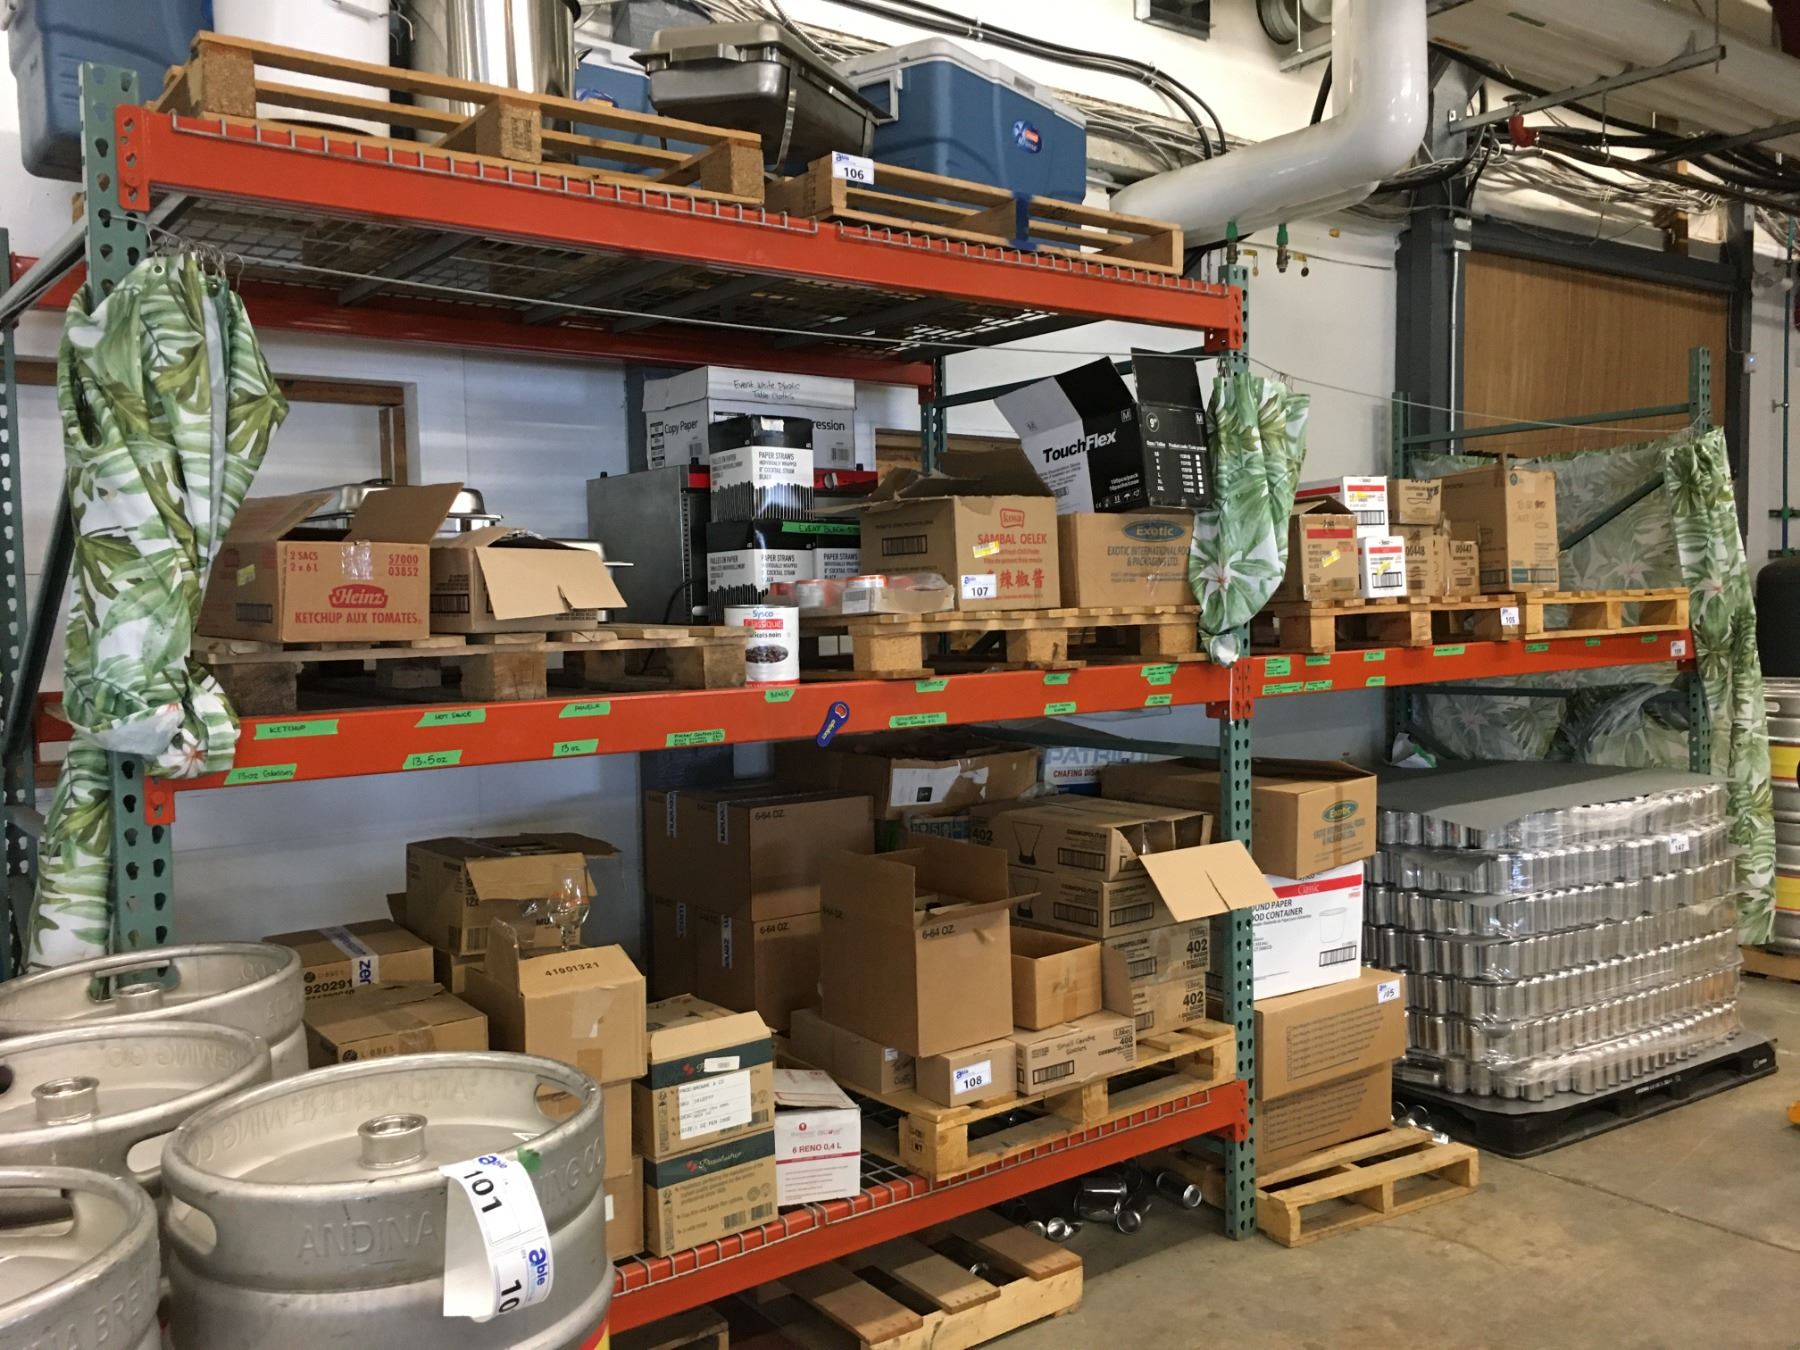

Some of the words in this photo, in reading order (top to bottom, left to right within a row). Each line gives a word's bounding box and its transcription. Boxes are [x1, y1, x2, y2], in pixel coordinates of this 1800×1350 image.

[844, 167, 864, 180] 106
[664, 423, 679, 436] Copy
[680, 419, 698, 433] Paper
[1043, 430, 1117, 463] TouchFlex
[776, 452, 794, 460] STRAWS
[1136, 526, 1174, 536] Exotic
[978, 534, 1016, 544] SAMBAL
[1020, 533, 1047, 544] OELEK
[298, 552, 318, 560] SACS
[777, 554, 795, 562] STRAWS
[306, 563, 311, 572] 6
[388, 566, 418, 576] 03852
[332, 588, 385, 605] Heinz
[972, 586, 988, 596] 107
[295, 612, 343, 624] KETCHUP
[346, 612, 368, 624] AUX
[372, 612, 418, 624] TOMATES
[752, 609, 774, 619] Sysco
[1053, 769, 1082, 778] CHAFING
[772, 810, 785, 818] OZ
[972, 828, 993, 842] 402
[1271, 899, 1292, 909] PAPER
[1266, 907, 1304, 920] CONTAINER
[760, 926, 776, 934] 6-64
[777, 922, 790, 932] OZ
[922, 928, 940, 940] 6-64
[942, 924, 956, 936] OZ
[1186, 939, 1208, 954] 402
[304, 978, 352, 996] 920291
[1183, 991, 1204, 1006] 402
[1120, 1036, 1133, 1044] 400
[1098, 1043, 1134, 1056] COSMOPOLITAN
[964, 1075, 982, 1088] 108
[792, 1146, 798, 1154] 6
[799, 1143, 822, 1153] RENO
[464, 1170, 502, 1214] 101
[297, 1208, 440, 1260] ANDINA
[528, 1248, 548, 1286] able
